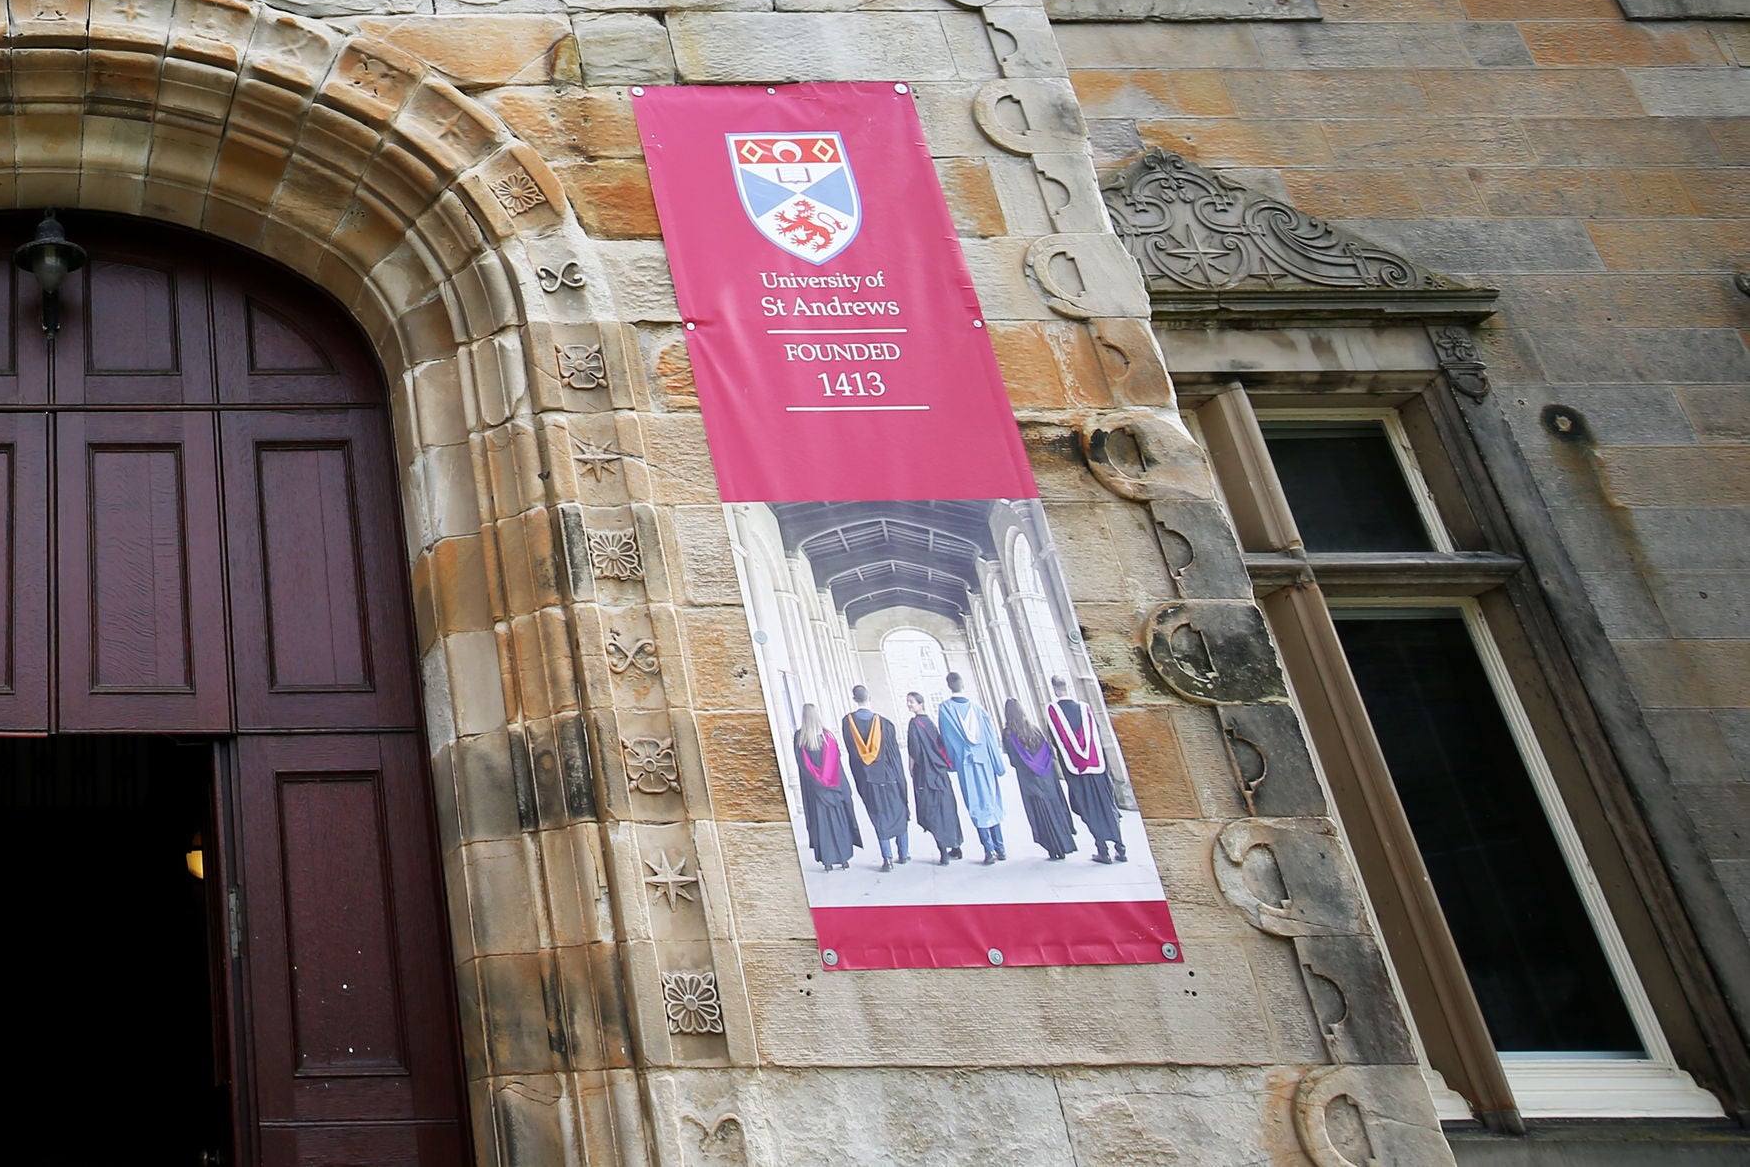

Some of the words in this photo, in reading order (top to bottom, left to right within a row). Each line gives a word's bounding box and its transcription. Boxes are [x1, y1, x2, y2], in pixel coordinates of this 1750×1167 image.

[760, 272, 862, 293] University
[864, 271, 885, 288] of
[761, 297, 787, 317] St
[792, 296, 900, 316] Andrews
[783, 343, 901, 361] FOUNDED
[817, 372, 886, 397] 1413
